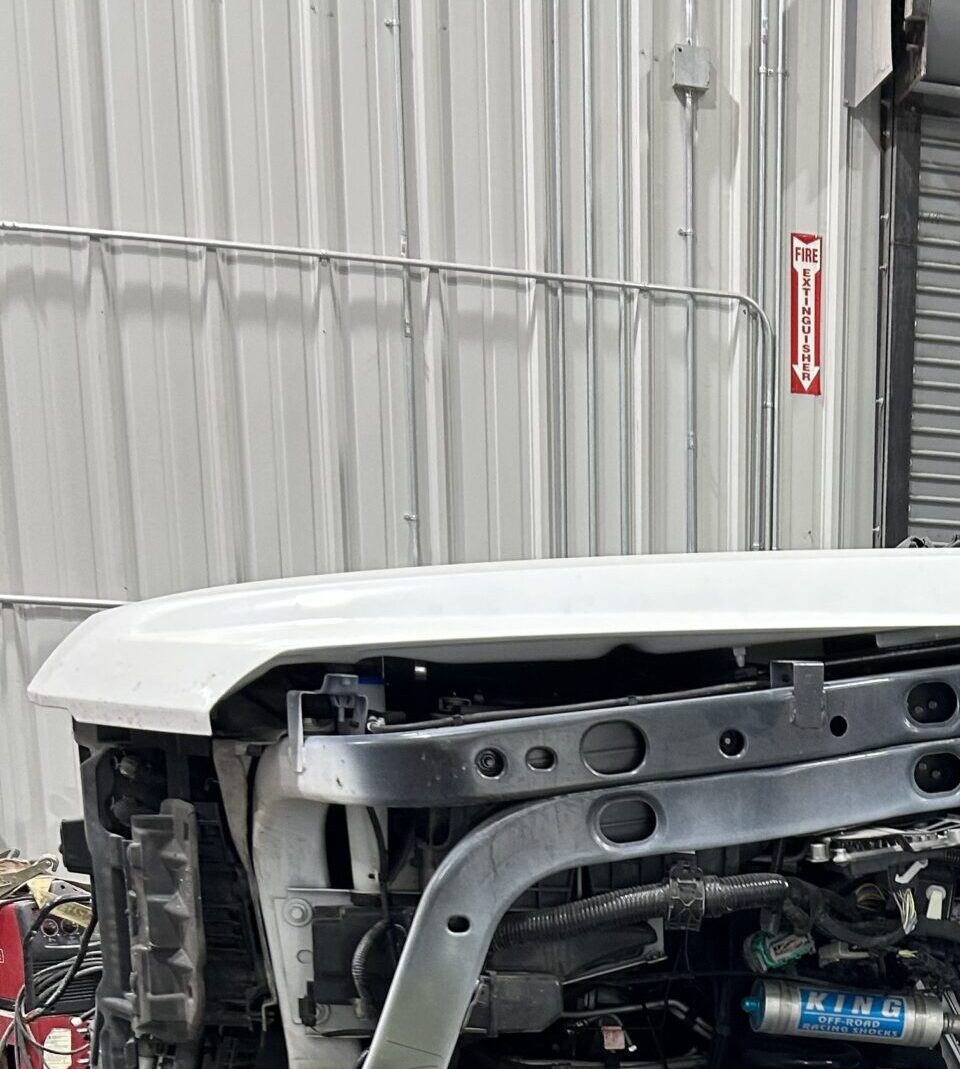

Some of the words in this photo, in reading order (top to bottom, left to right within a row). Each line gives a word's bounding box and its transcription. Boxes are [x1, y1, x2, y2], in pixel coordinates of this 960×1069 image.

[795, 247, 818, 263] FIRE
[801, 268, 812, 381] EXTINGUISHER
[806, 991, 902, 1018] KING
[802, 1023, 849, 1034] RACING
[852, 1027, 898, 1037] SHOCKS
[818, 1016, 881, 1028] OFF-ROAD
